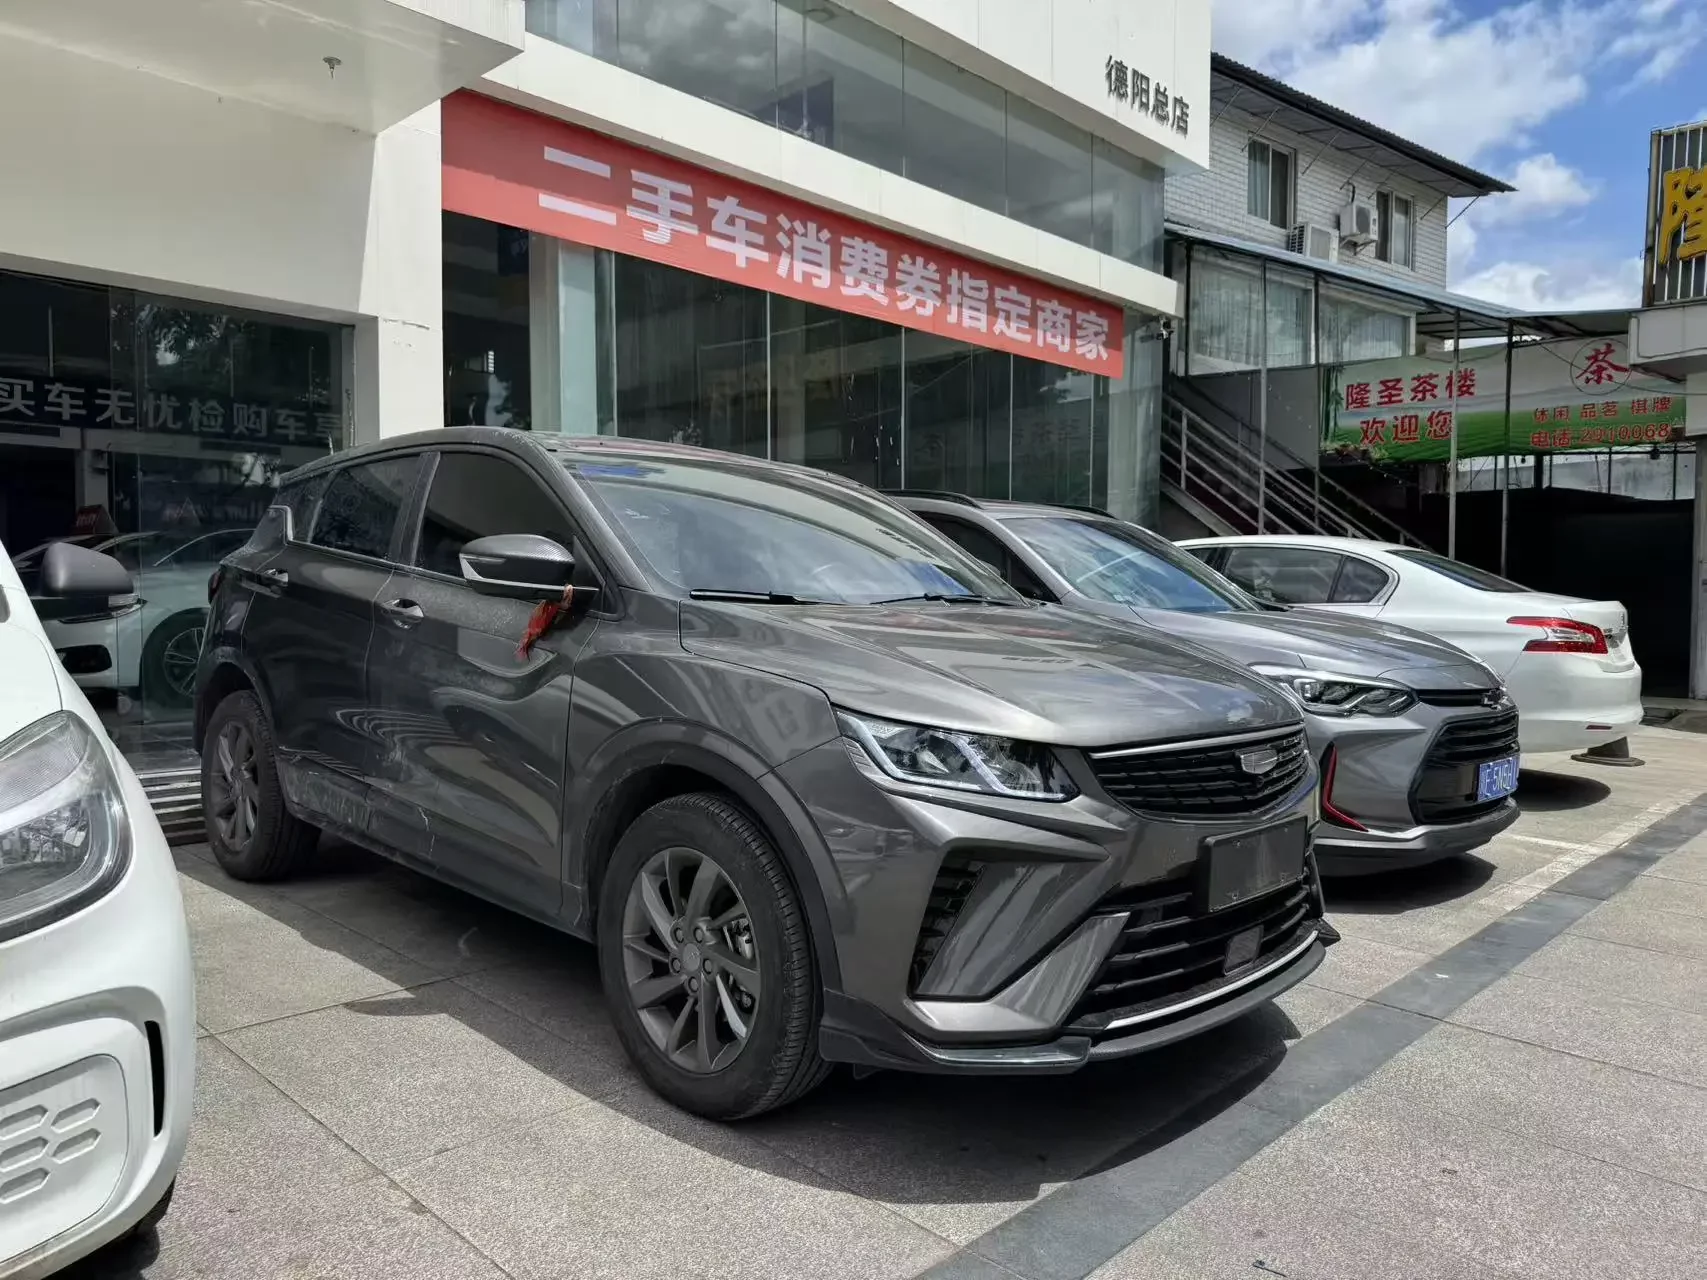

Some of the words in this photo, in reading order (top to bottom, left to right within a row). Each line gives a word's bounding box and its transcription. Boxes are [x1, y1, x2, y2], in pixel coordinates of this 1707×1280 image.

[1105, 55, 1190, 138] 德阳总店
[538, 145, 1109, 361] 二手车消费券指定商家
[1575, 342, 1630, 385] 茶
[1345, 367, 1476, 411] 隆圣茶楼
[1533, 406, 1570, 424] 休闲
[1580, 401, 1618, 420] 品茗
[1632, 396, 1673, 416] 棋牌
[1359, 409, 1452, 445] 欢迎您
[1530, 428, 1573, 449] 电话
